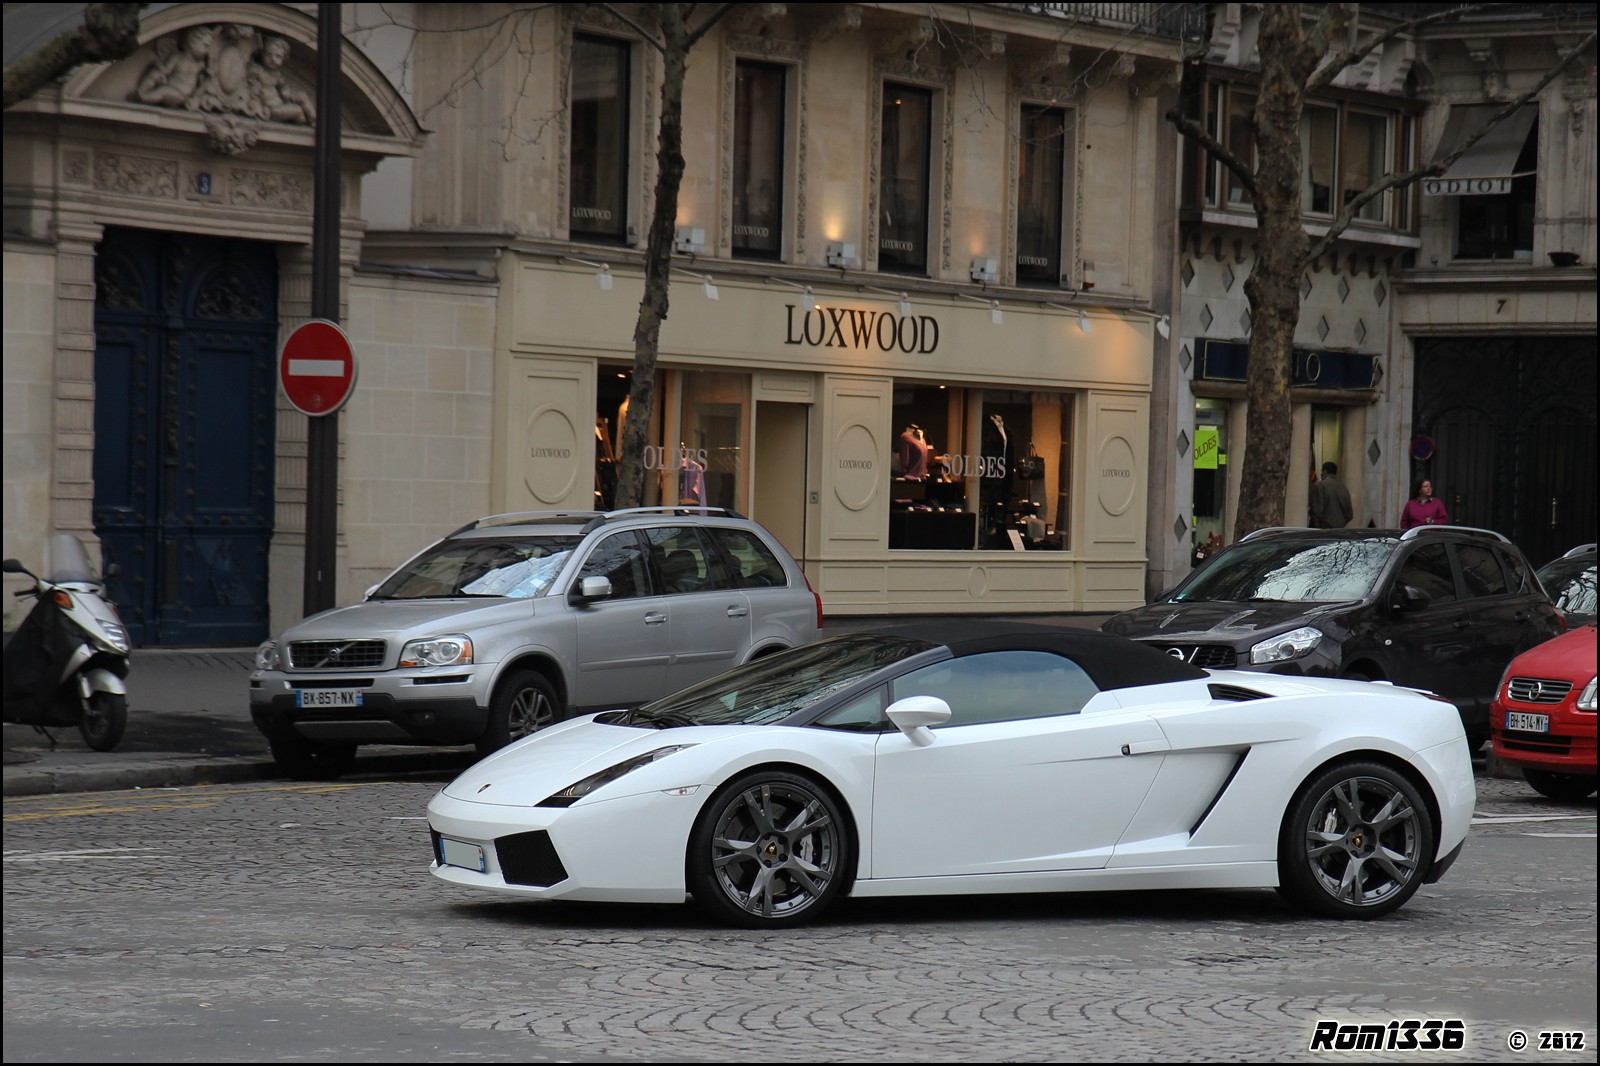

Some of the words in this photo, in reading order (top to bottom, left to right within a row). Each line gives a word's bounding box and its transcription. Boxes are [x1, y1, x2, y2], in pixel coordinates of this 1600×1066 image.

[200, 176, 209, 193] 3
[1427, 179, 1509, 194] ODIOT
[572, 207, 611, 221] LOXWOOD
[734, 224, 769, 238] LOXWOOD
[881, 238, 913, 251] LOXWOOD
[1018, 255, 1048, 267] LOXWOOD
[1496, 299, 1507, 314] 7
[784, 304, 939, 354] LOXWOOD
[531, 448, 570, 459] LOXWOOD
[1193, 435, 1217, 460] OLDES
[643, 445, 708, 473] OLDES
[839, 459, 872, 470] LOXWOOD
[941, 453, 1006, 479] SOLDES
[1102, 468, 1130, 479] LOXWOOD
[303, 691, 354, 705] BX-857-NX
